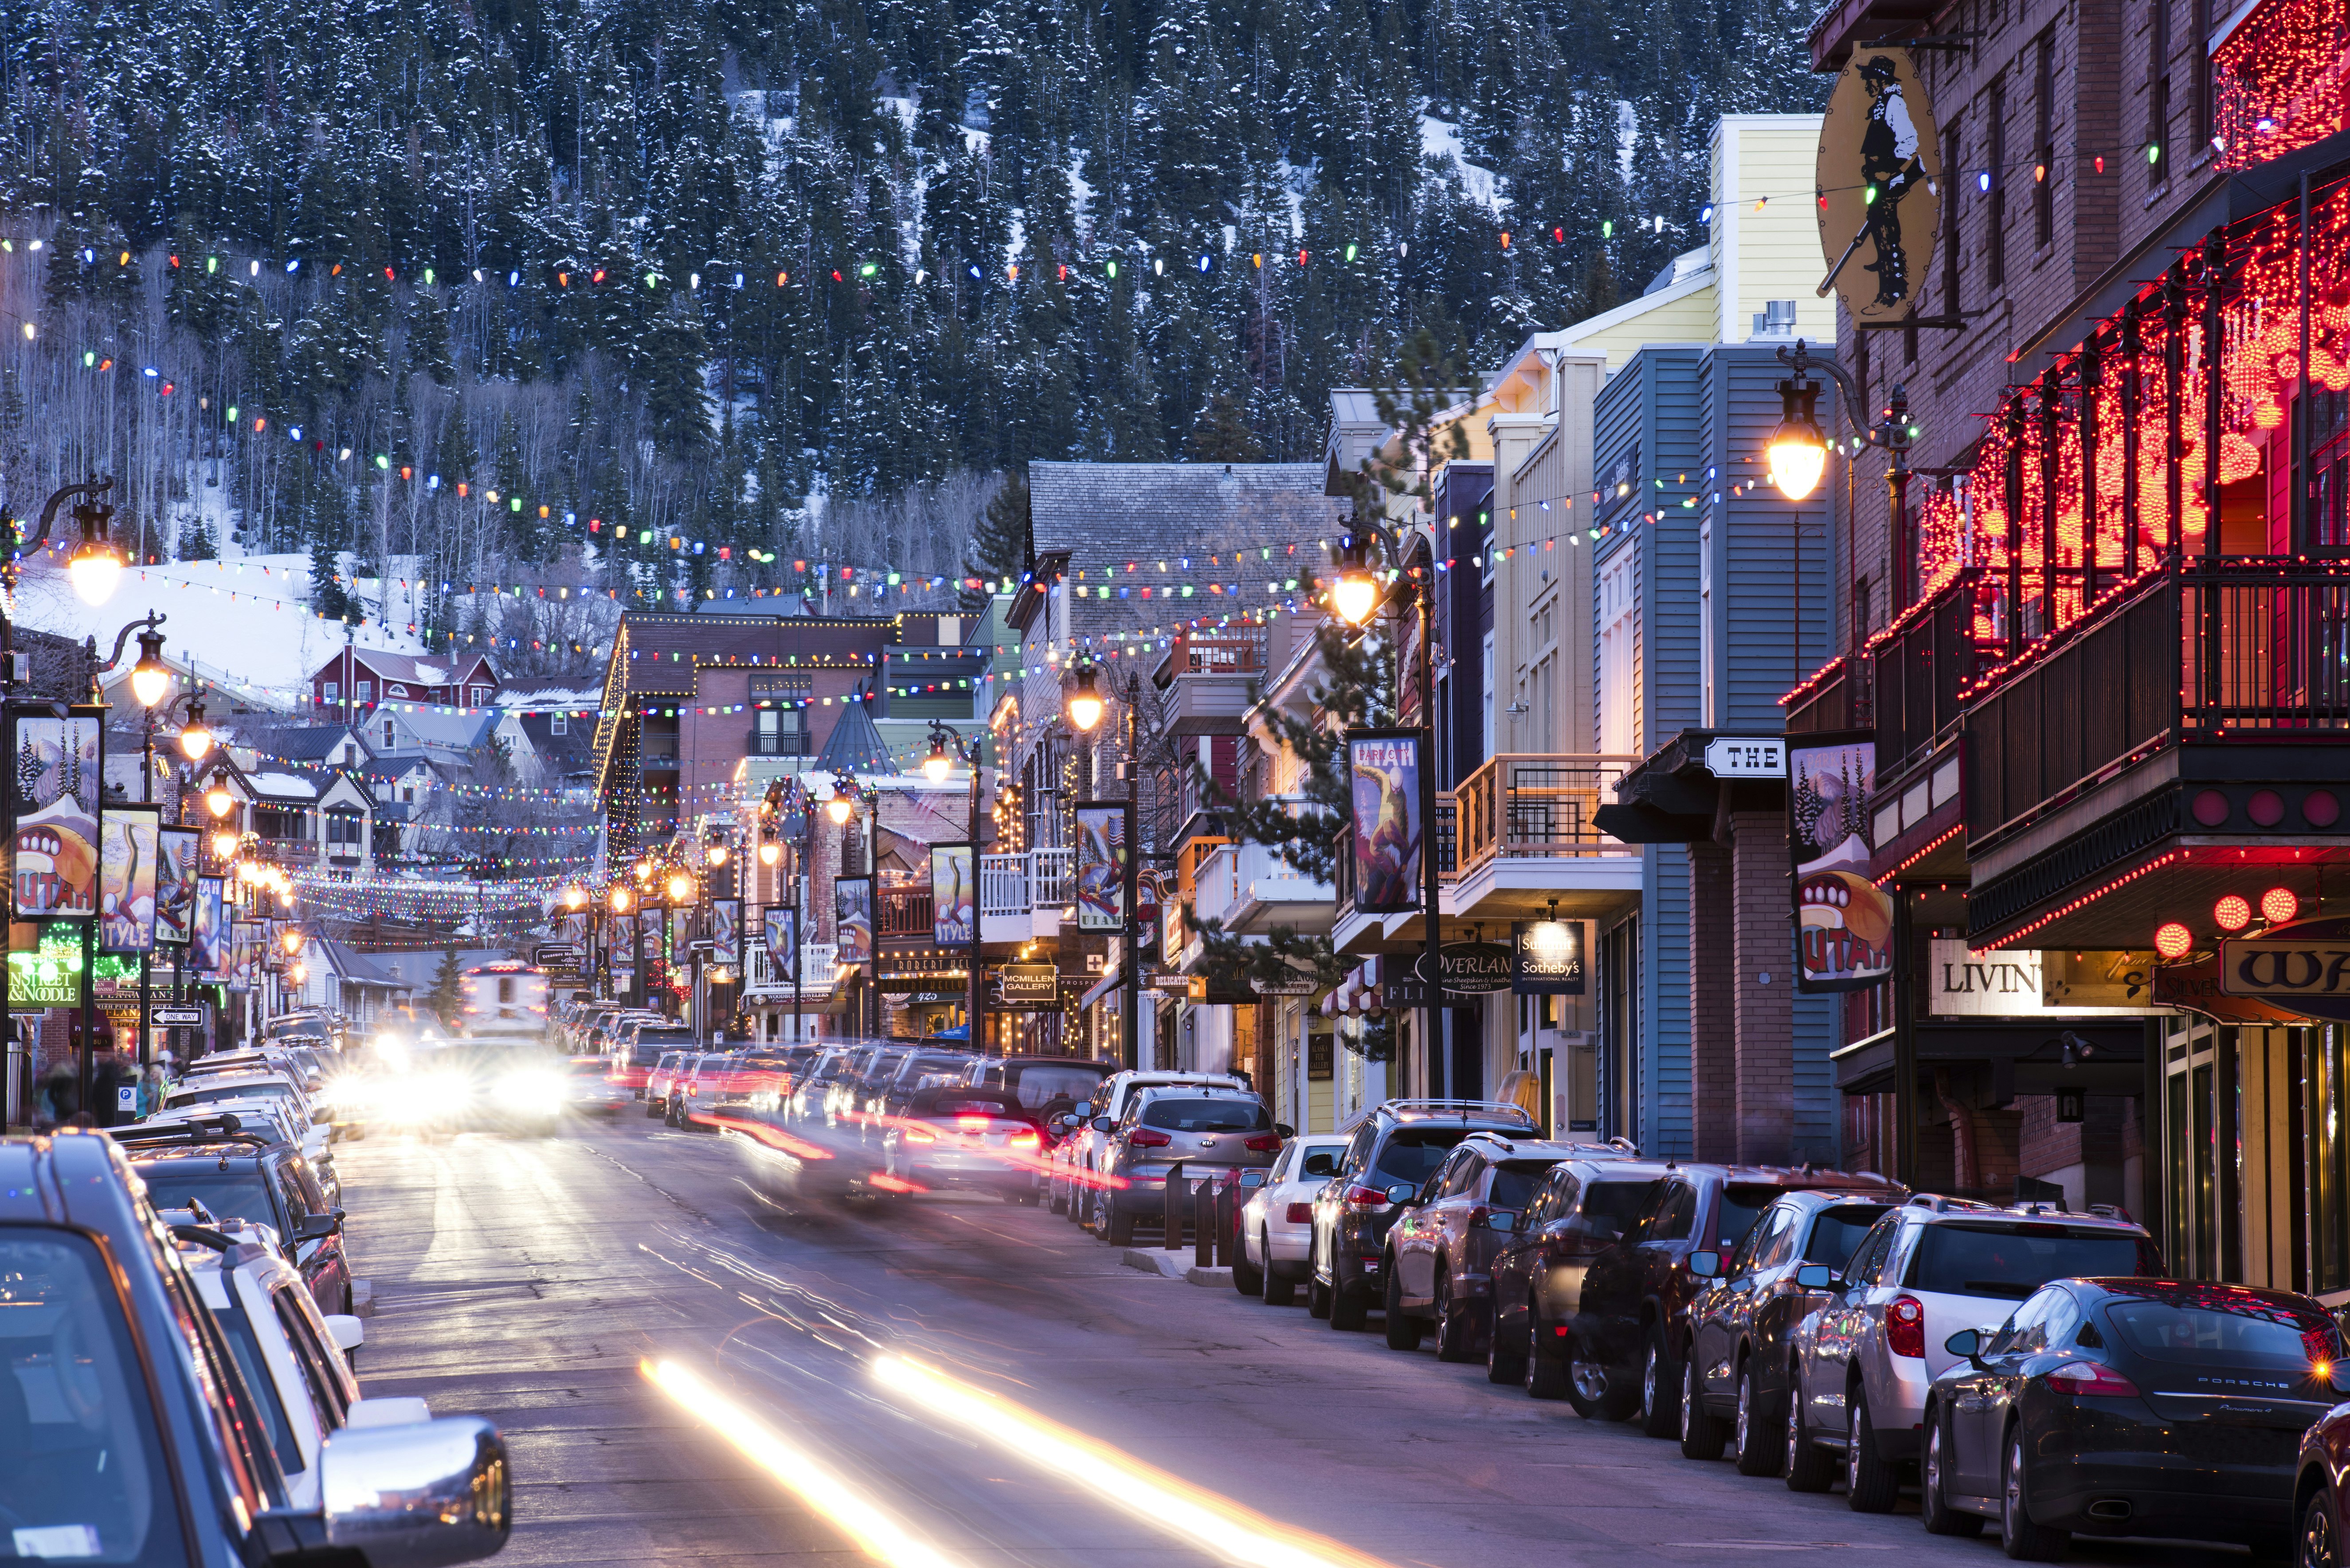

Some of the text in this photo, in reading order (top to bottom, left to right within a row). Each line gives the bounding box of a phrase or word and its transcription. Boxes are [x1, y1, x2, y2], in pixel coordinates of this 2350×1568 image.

[1355, 742, 1414, 766] UTAH
[1359, 749, 1409, 760] PARK CITY
[1728, 747, 1778, 768] THE
[1806, 752, 1839, 769] PARK
[1154, 869, 1173, 883] MAIN
[767, 911, 792, 922] UTAH
[1082, 915, 1122, 925] UTAH
[156, 928, 188, 939] TAH
[938, 924, 971, 941] STYLE
[1803, 926, 1894, 974] UTAH
[898, 959, 984, 970] ROBERT KELY
[1522, 961, 1579, 977] Sotheby's
[880, 980, 964, 991] ROBERT KELLY
[1155, 976, 1189, 985] DELICATES
[8, 985, 76, 1001] &NOODLE
[917, 993, 937, 1001] 425
[2198, 1377, 2289, 1388] PORSCHE
